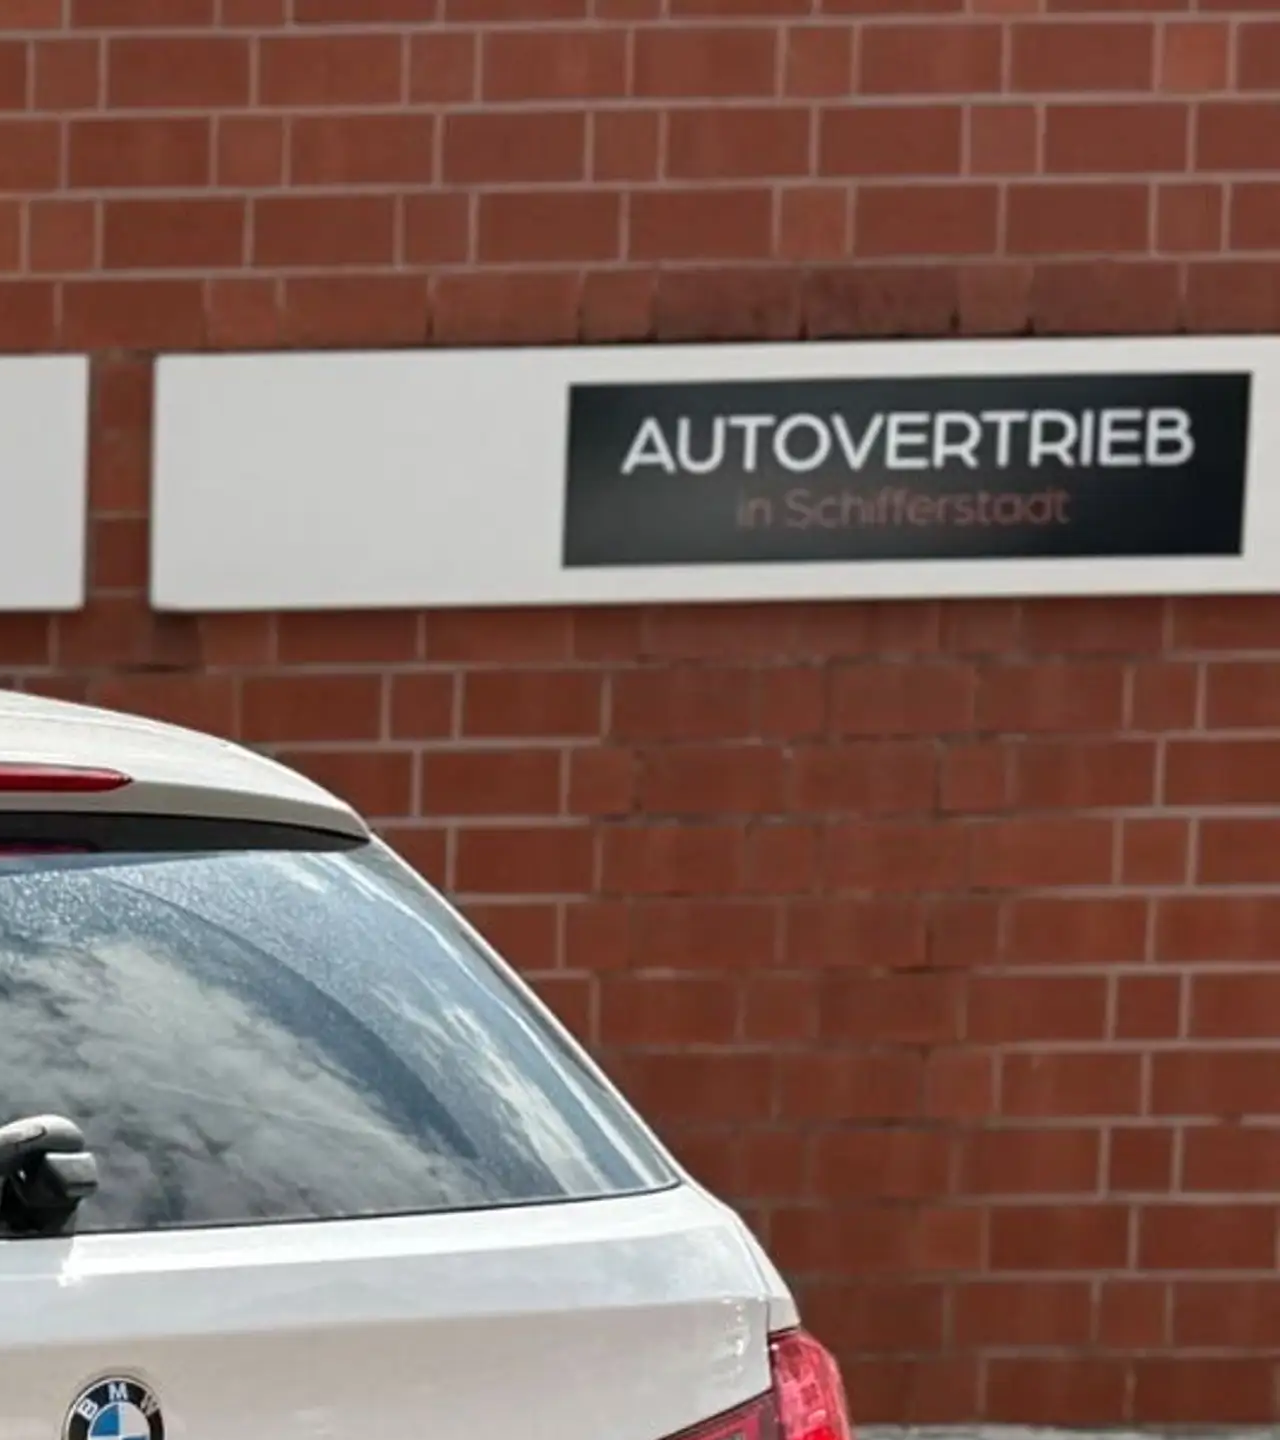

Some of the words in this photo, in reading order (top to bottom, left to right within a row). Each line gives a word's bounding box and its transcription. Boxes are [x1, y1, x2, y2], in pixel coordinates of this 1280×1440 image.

[621, 408, 1195, 474] AUTOVERTRIEB
[738, 493, 771, 527] in
[785, 486, 1071, 530] Schifferstadt
[77, 1382, 159, 1421] BMW
